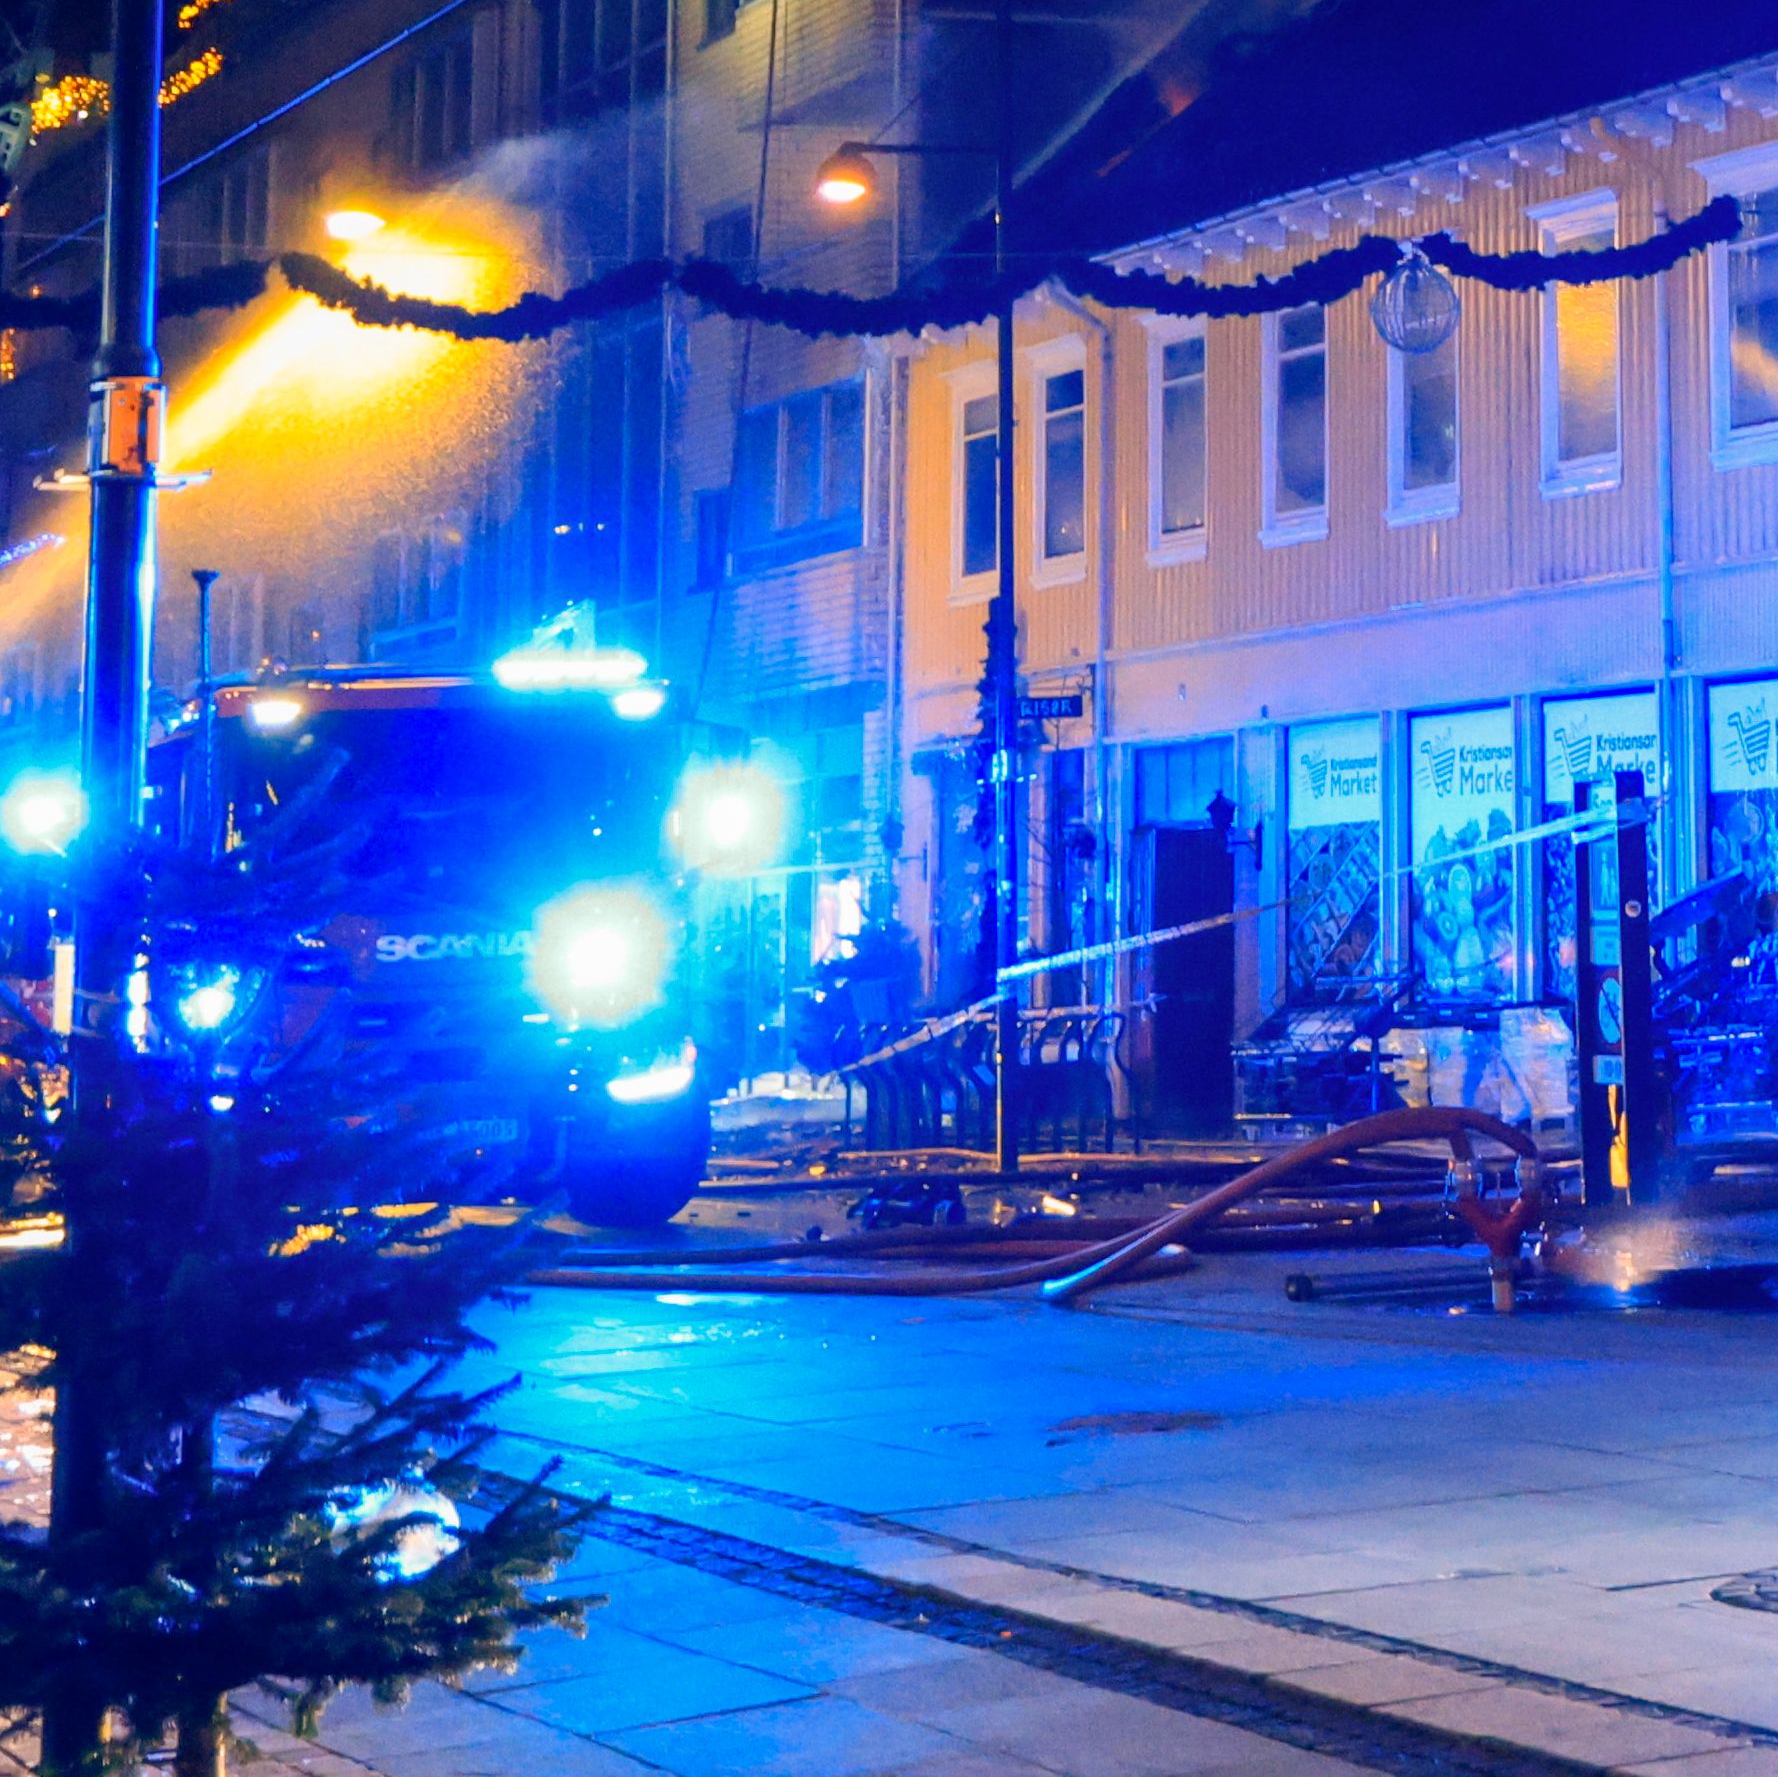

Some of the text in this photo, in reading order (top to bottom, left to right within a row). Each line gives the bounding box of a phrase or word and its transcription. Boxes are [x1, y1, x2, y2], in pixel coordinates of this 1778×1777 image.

[1331, 771, 1377, 798] Market
[1460, 763, 1513, 797] Marke
[376, 930, 535, 962] SCANIA
